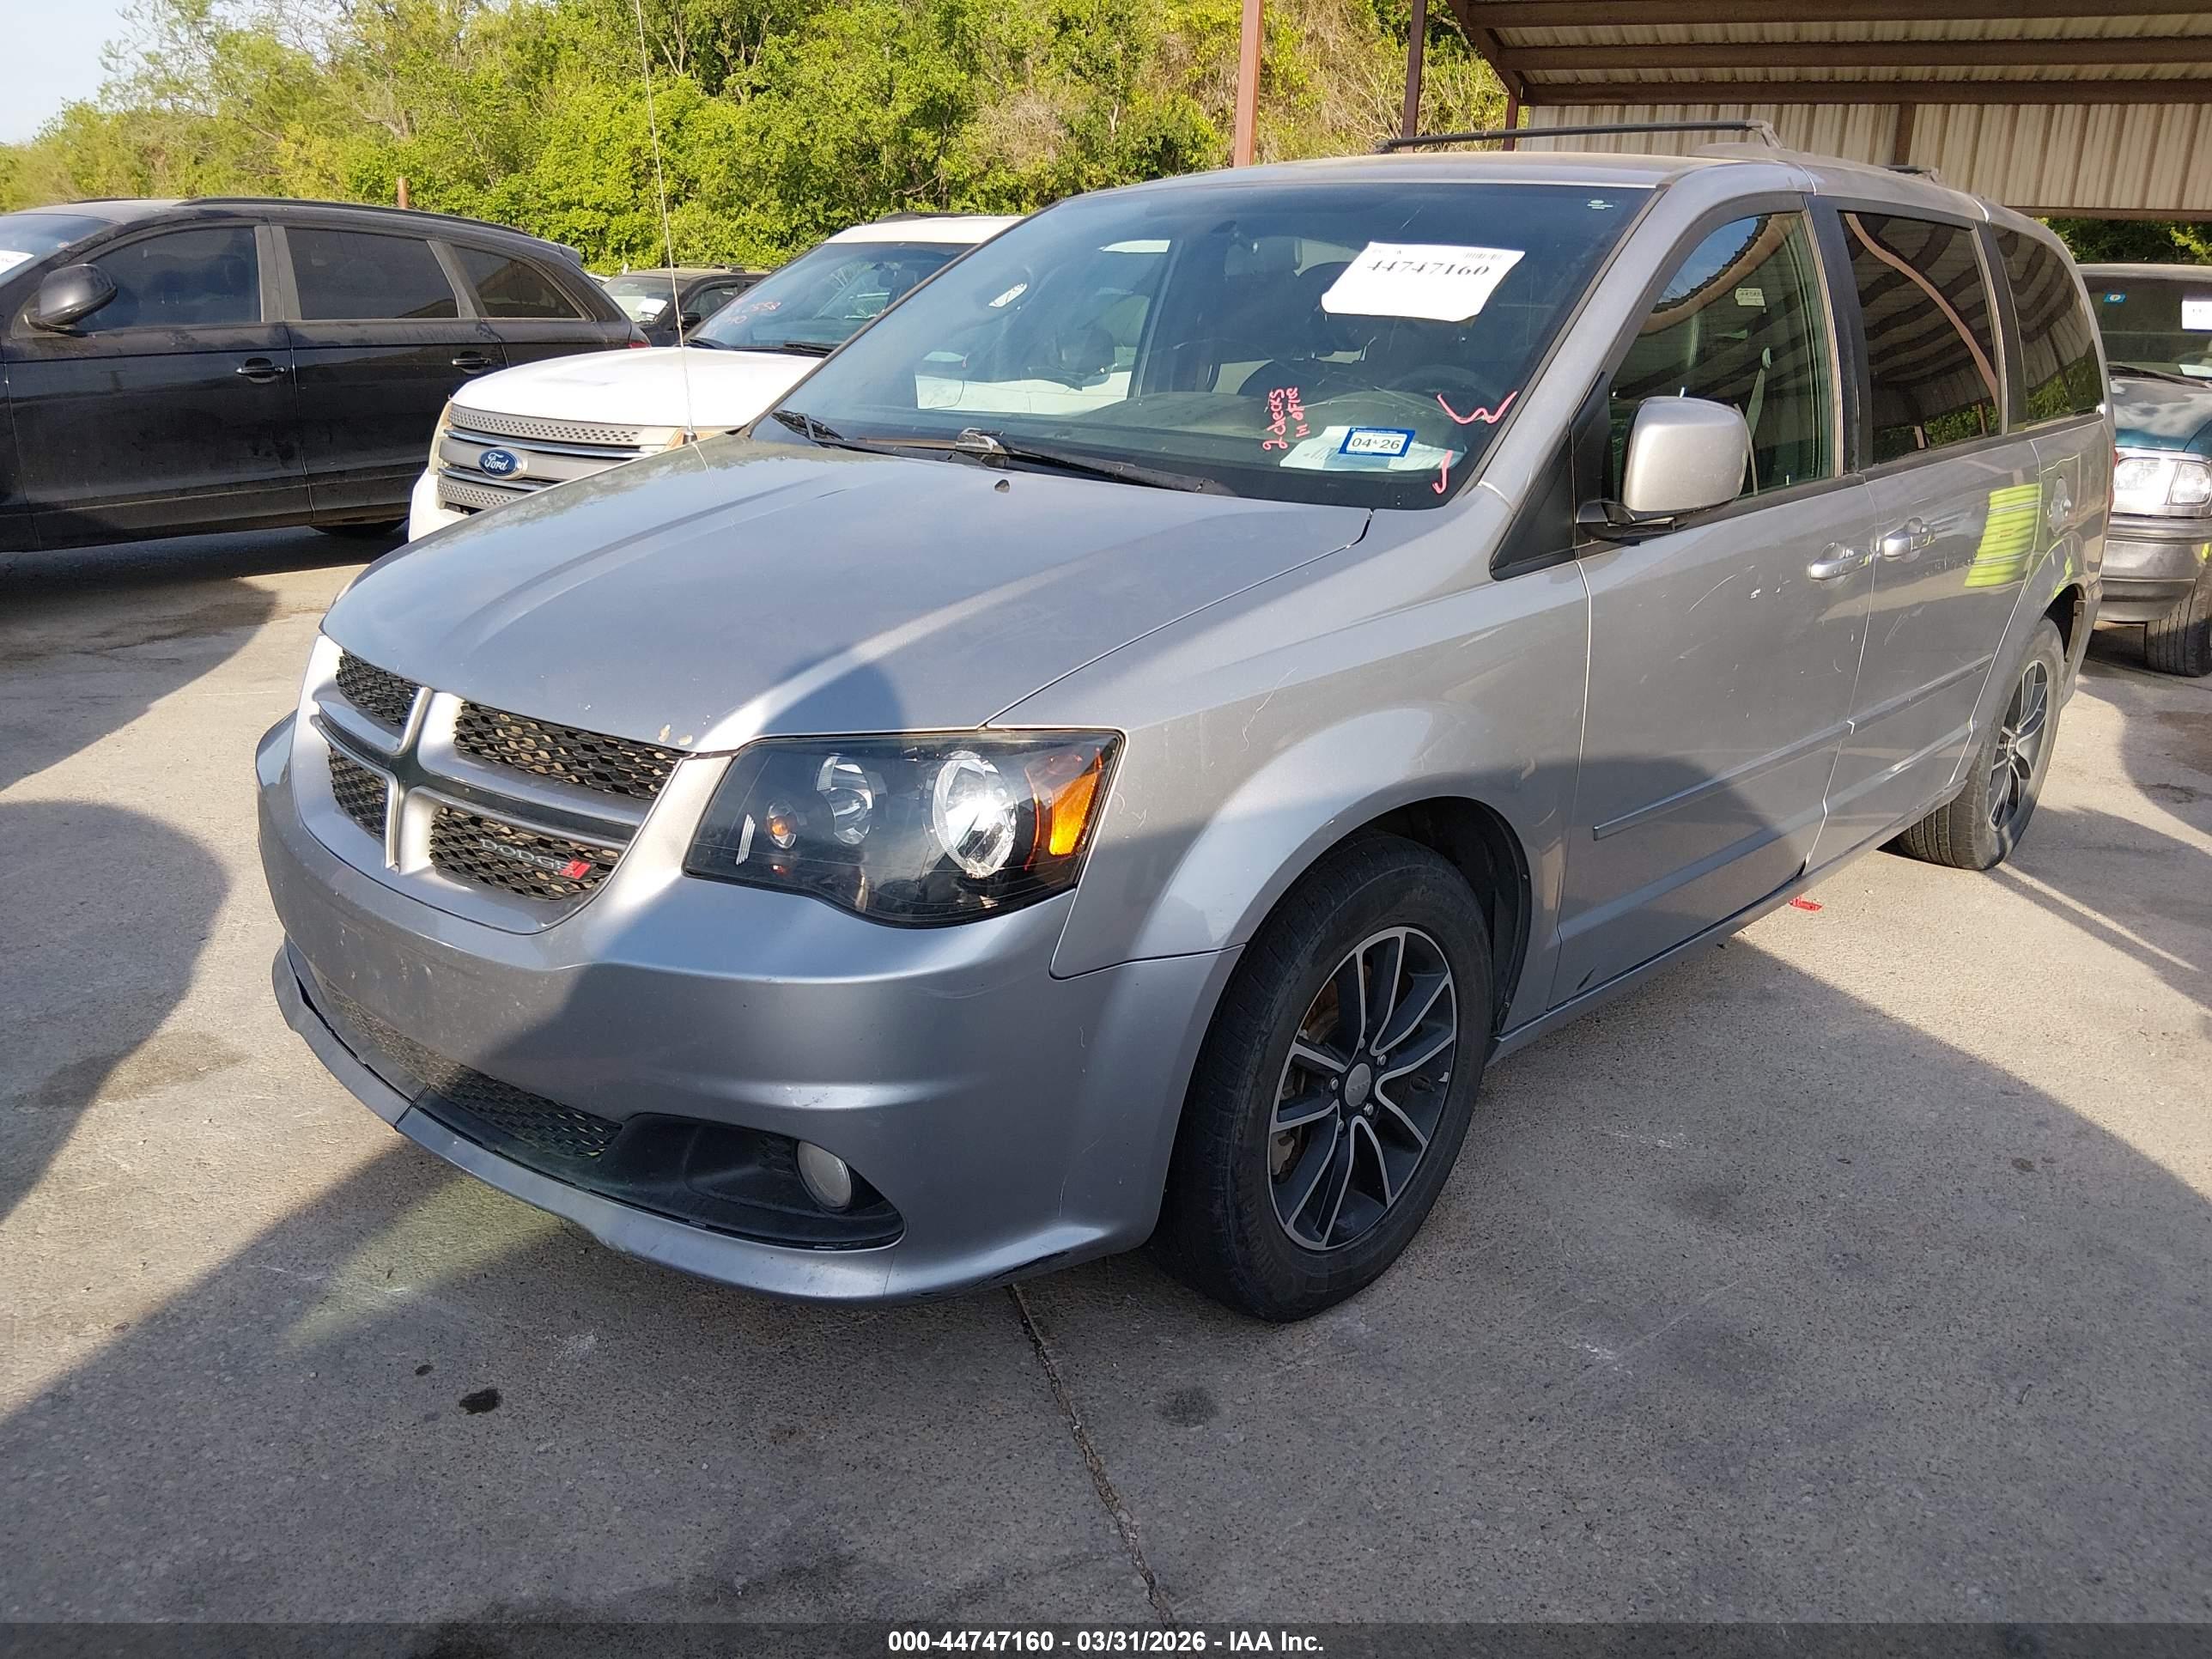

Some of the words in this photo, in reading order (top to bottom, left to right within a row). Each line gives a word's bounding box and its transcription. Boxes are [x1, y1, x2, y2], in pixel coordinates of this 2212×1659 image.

[1367, 260, 1490, 276] 44747160
[1351, 437, 1374, 448] 04
[1379, 439, 1402, 451] 26
[483, 452, 509, 471] Ford
[479, 838, 570, 872] DODGE
